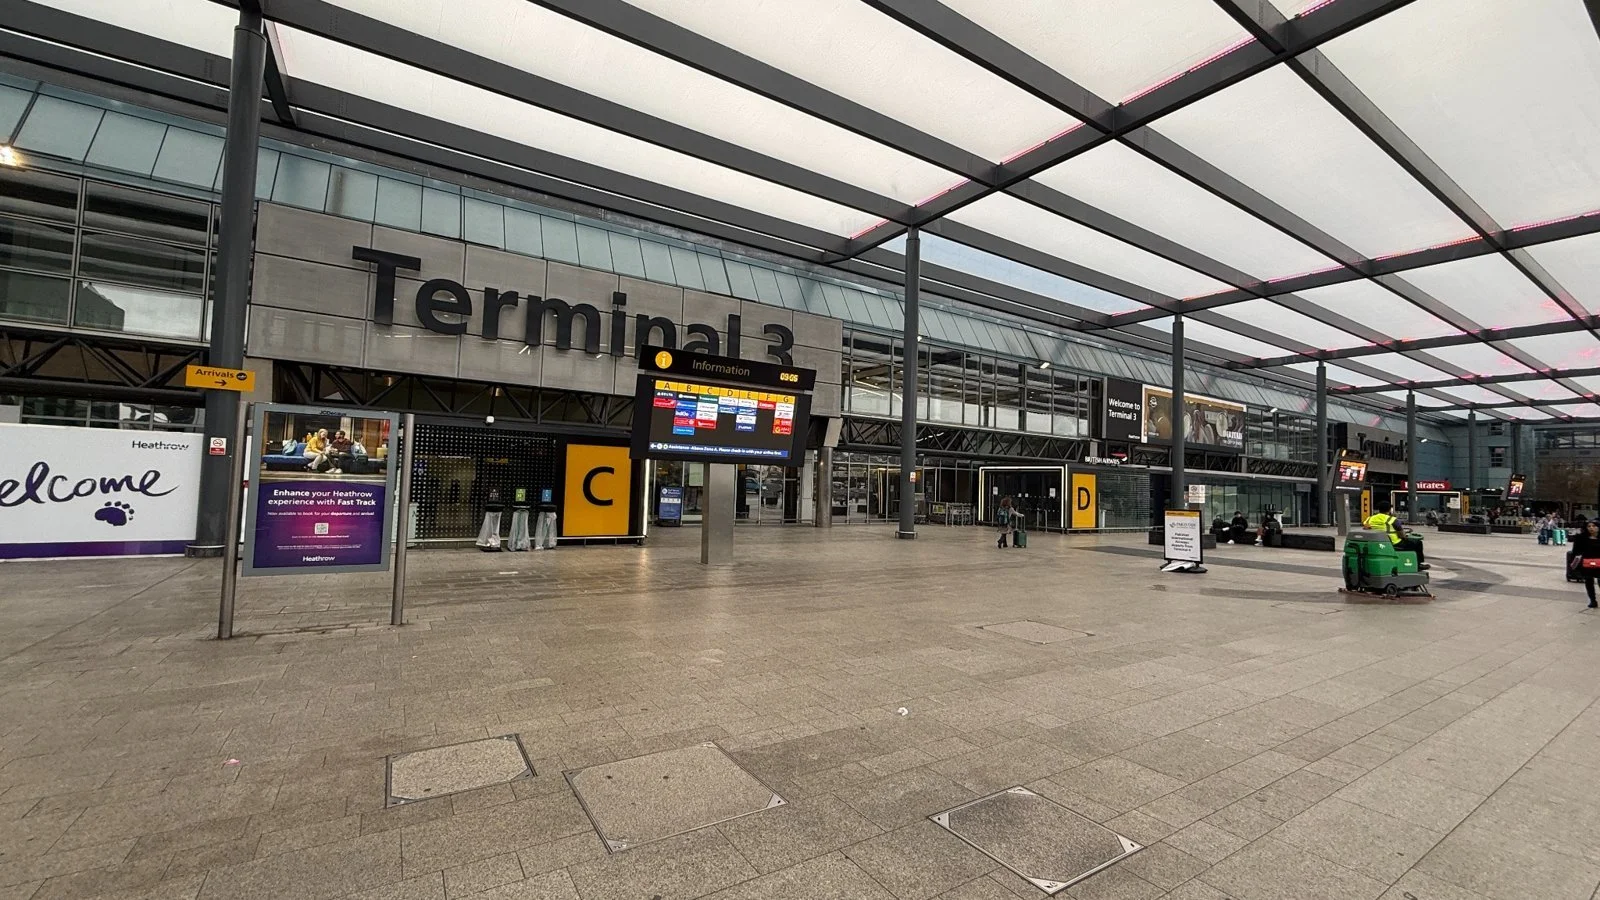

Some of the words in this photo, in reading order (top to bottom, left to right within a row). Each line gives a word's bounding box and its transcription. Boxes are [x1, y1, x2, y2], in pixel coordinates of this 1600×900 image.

[352, 245, 741, 358] Terminal
[763, 322, 796, 367] 3
[194, 368, 235, 379] Arrivals
[692, 359, 750, 377] Information
[1108, 398, 1134, 410] Welcome
[1134, 403, 1141, 411] to
[1108, 409, 1133, 420] Terminal
[1133, 413, 1137, 421] 3
[132, 440, 190, 451] Heathrow
[0, 461, 181, 507] elcome
[582, 466, 615, 507] C
[273, 489, 310, 497] Enhance
[311, 490, 331, 498] your
[332, 490, 373, 498] Heathrow
[1077, 486, 1091, 511] D
[268, 498, 315, 506] experience
